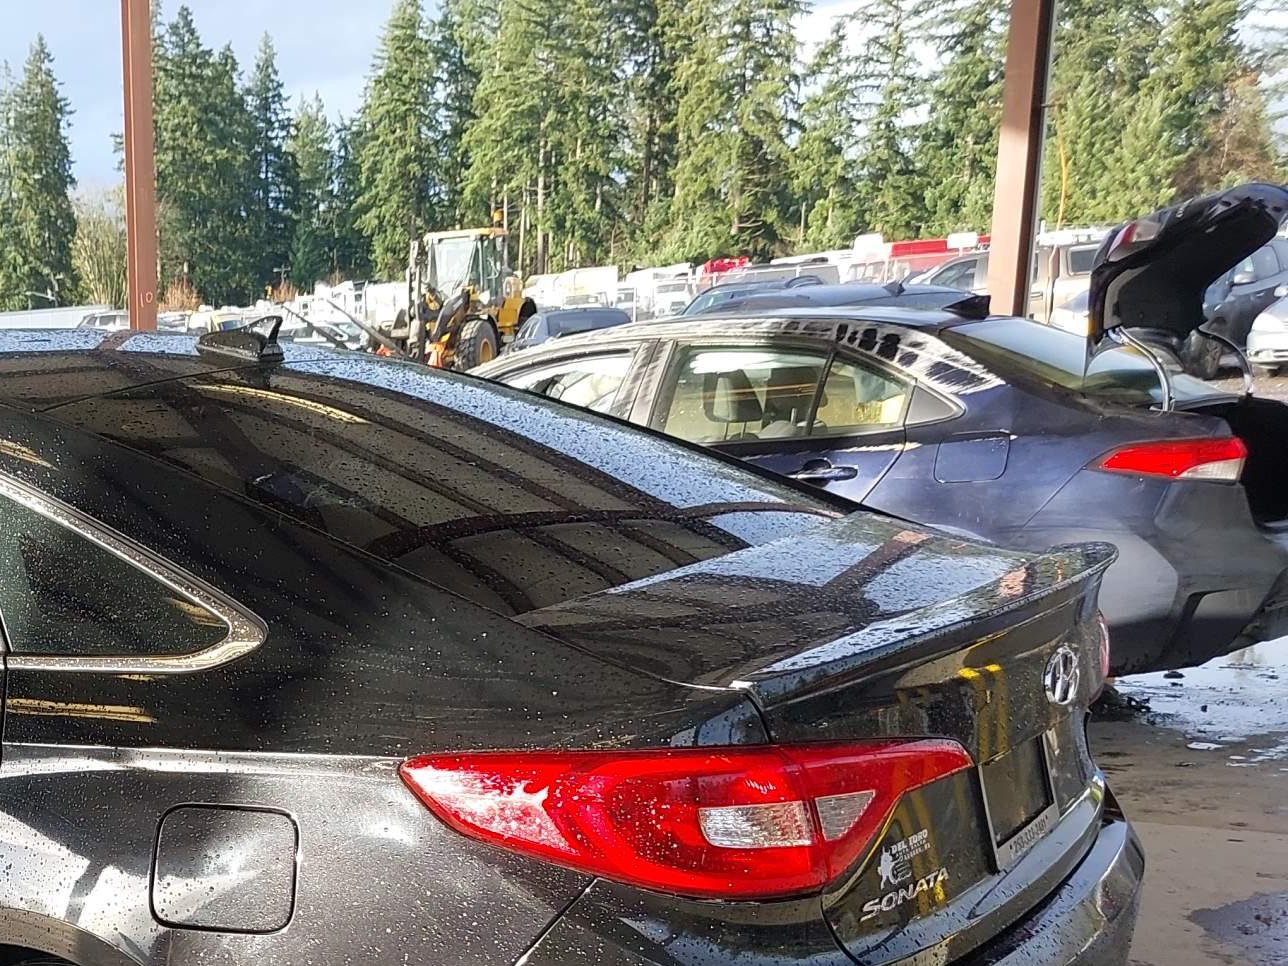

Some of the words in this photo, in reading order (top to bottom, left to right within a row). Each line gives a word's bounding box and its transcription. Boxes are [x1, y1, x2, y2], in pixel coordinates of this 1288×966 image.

[891, 841, 907, 854] DEL
[908, 829, 928, 845] TORO
[859, 867, 950, 923] SONATA
